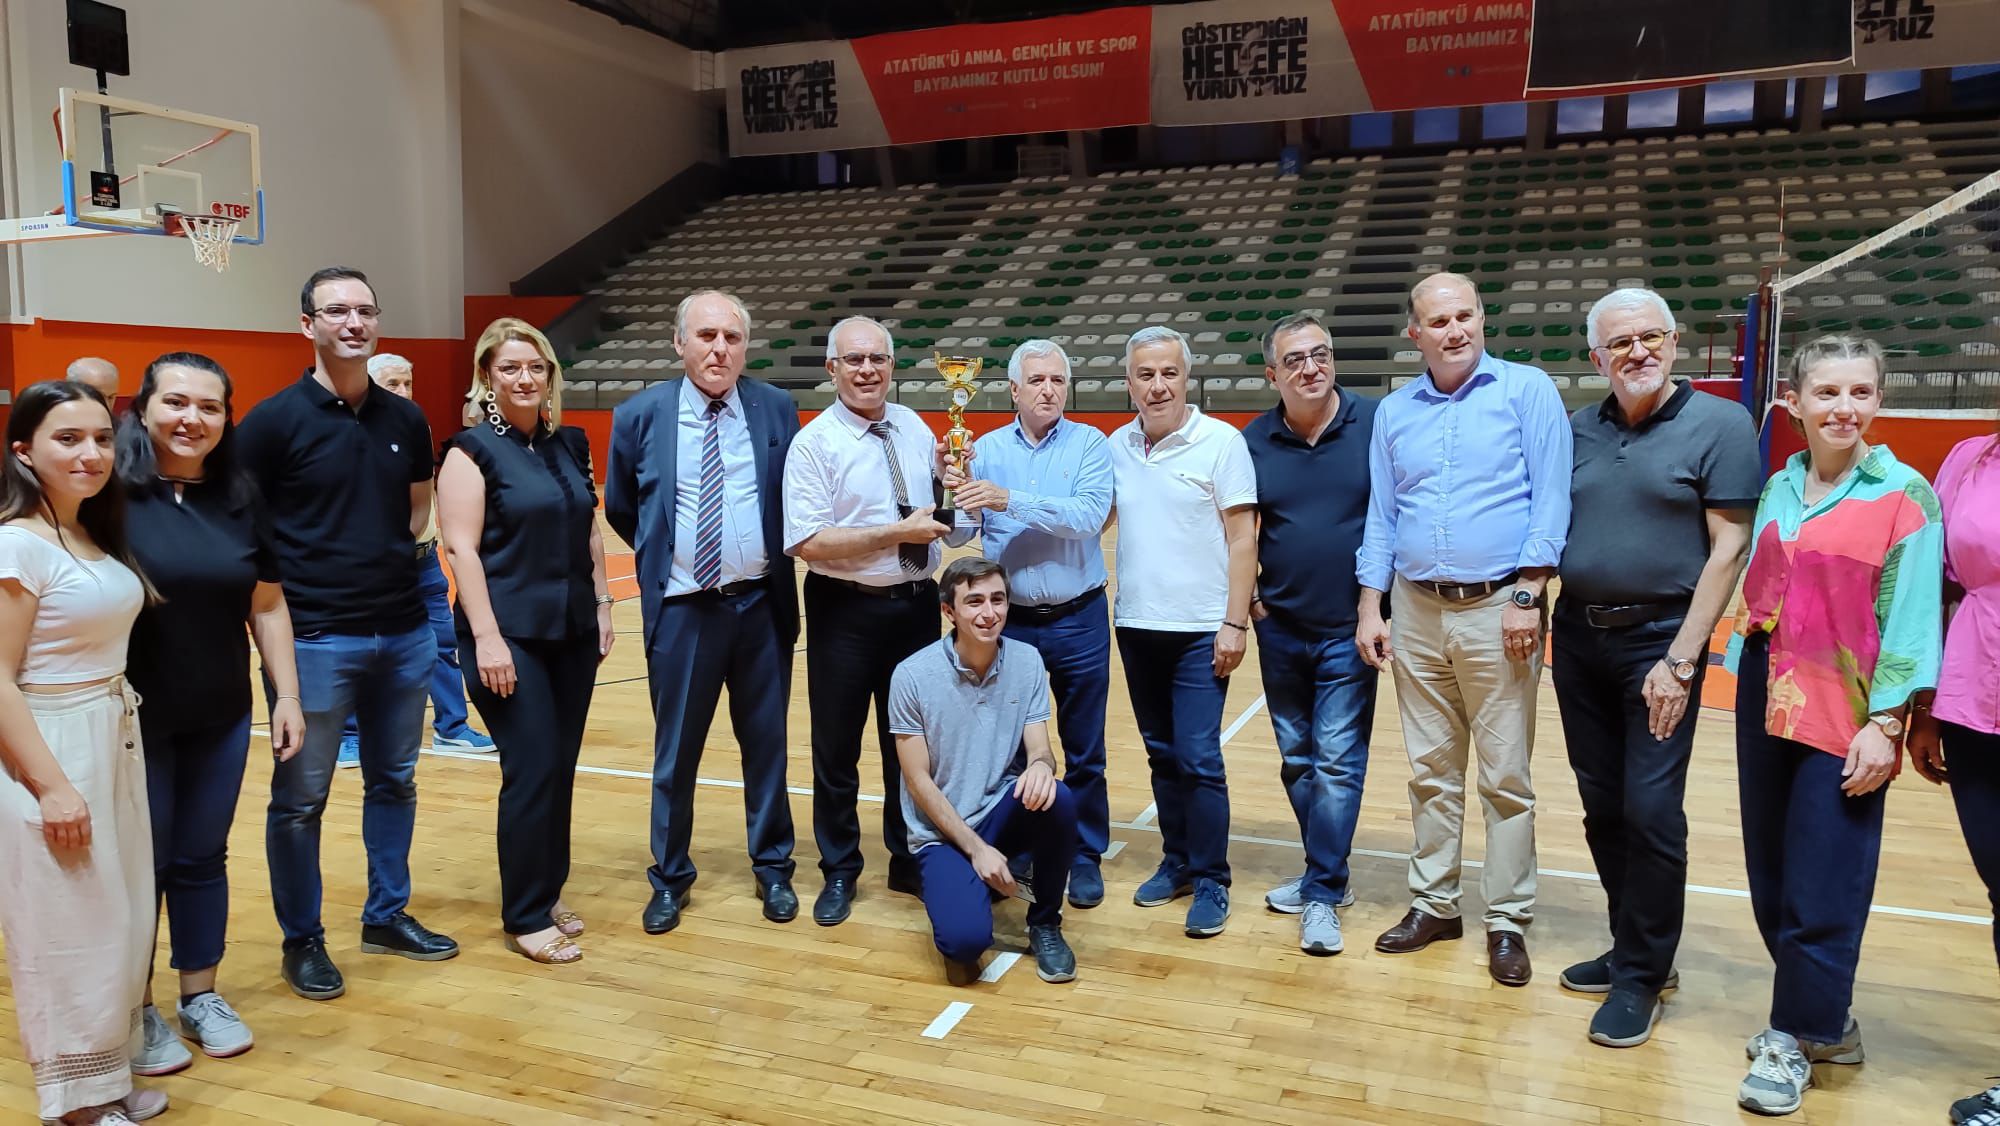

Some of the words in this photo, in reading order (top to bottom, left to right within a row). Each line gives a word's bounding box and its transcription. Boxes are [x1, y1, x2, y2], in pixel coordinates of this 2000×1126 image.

[1368, 4, 1468, 32] ATATÜRK'Ü
[883, 53, 960, 75] ATATÜRK'Ü
[964, 48, 1007, 65] ANMA,
[1012, 38, 1072, 61] GENÇLİK
[1077, 39, 1095, 55] VE
[1100, 35, 1138, 51] SPOR
[1406, 29, 1517, 53] BAYRAMIMIZ
[914, 71, 998, 93] BAYRAMIMIZ
[1003, 66, 1048, 85] KUTLU
[1052, 62, 1105, 80] OLSUN!
[224, 204, 250, 218] TBF
